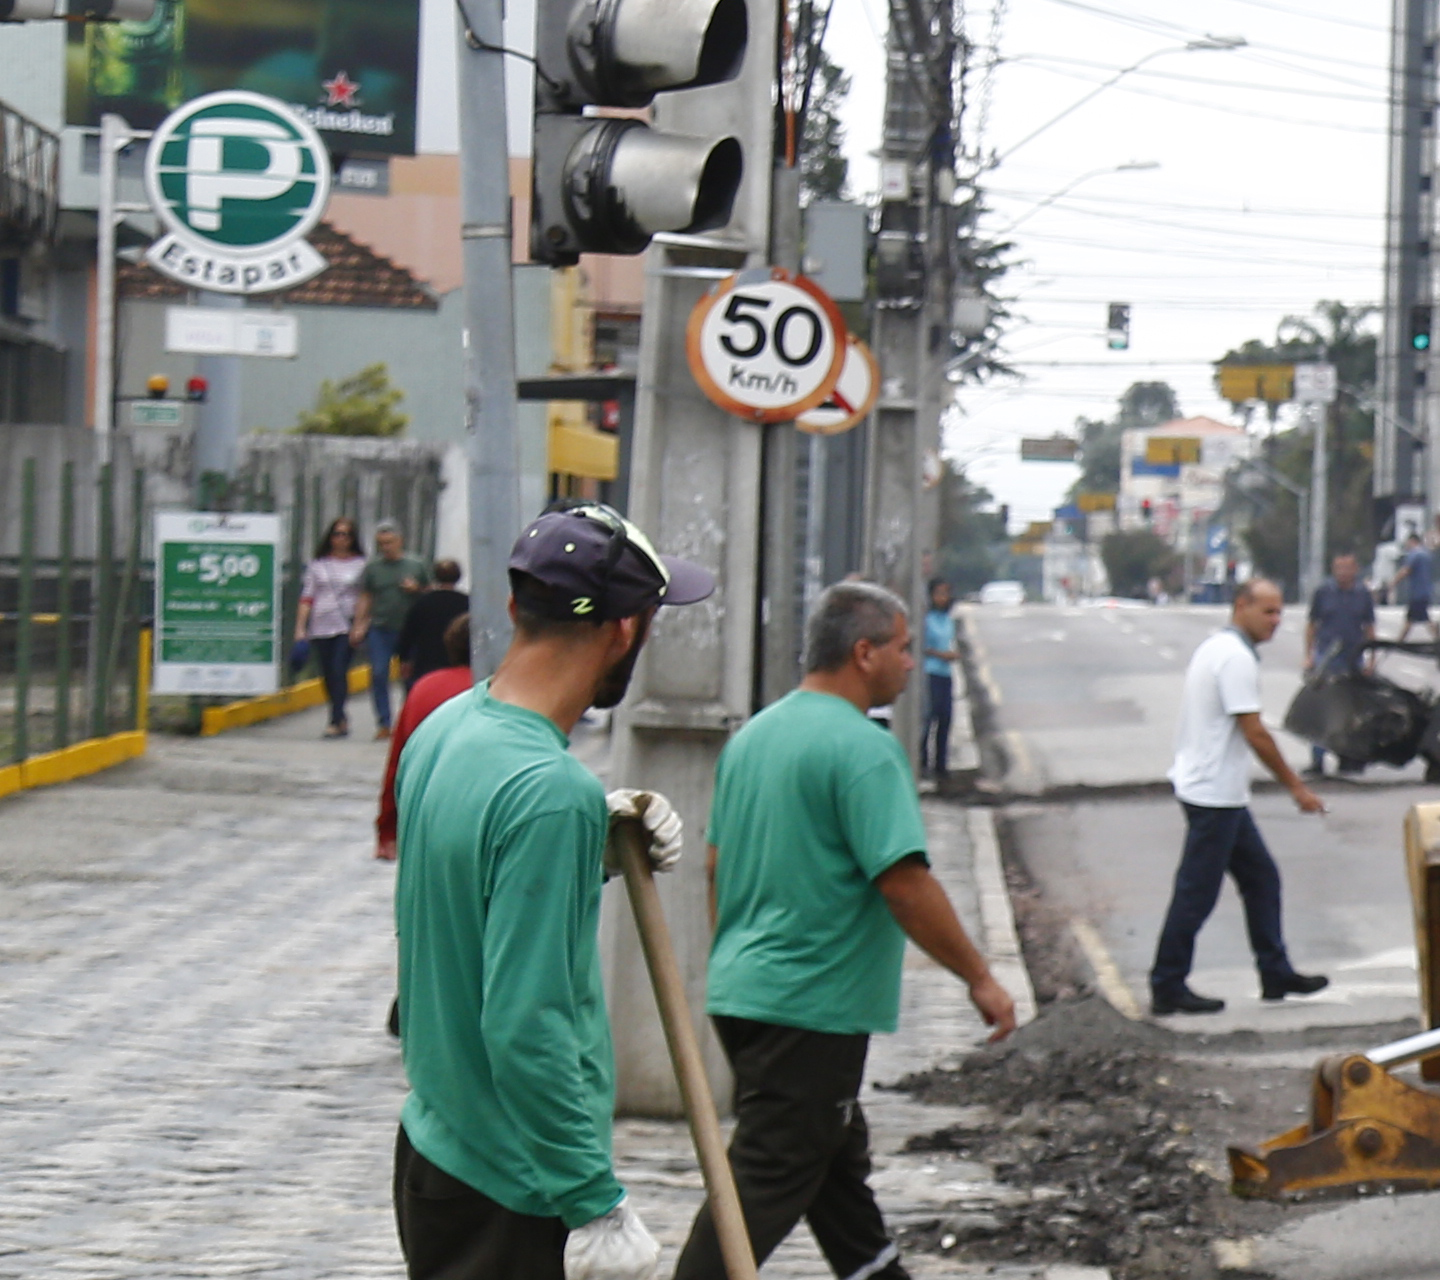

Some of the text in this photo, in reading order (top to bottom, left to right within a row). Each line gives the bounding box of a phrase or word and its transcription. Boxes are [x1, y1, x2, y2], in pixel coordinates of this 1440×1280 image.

[162, 242, 303, 289] Estapar
[719, 295, 824, 367] 50
[729, 365, 799, 395] Km/h
[199, 553, 260, 587] 5,00
